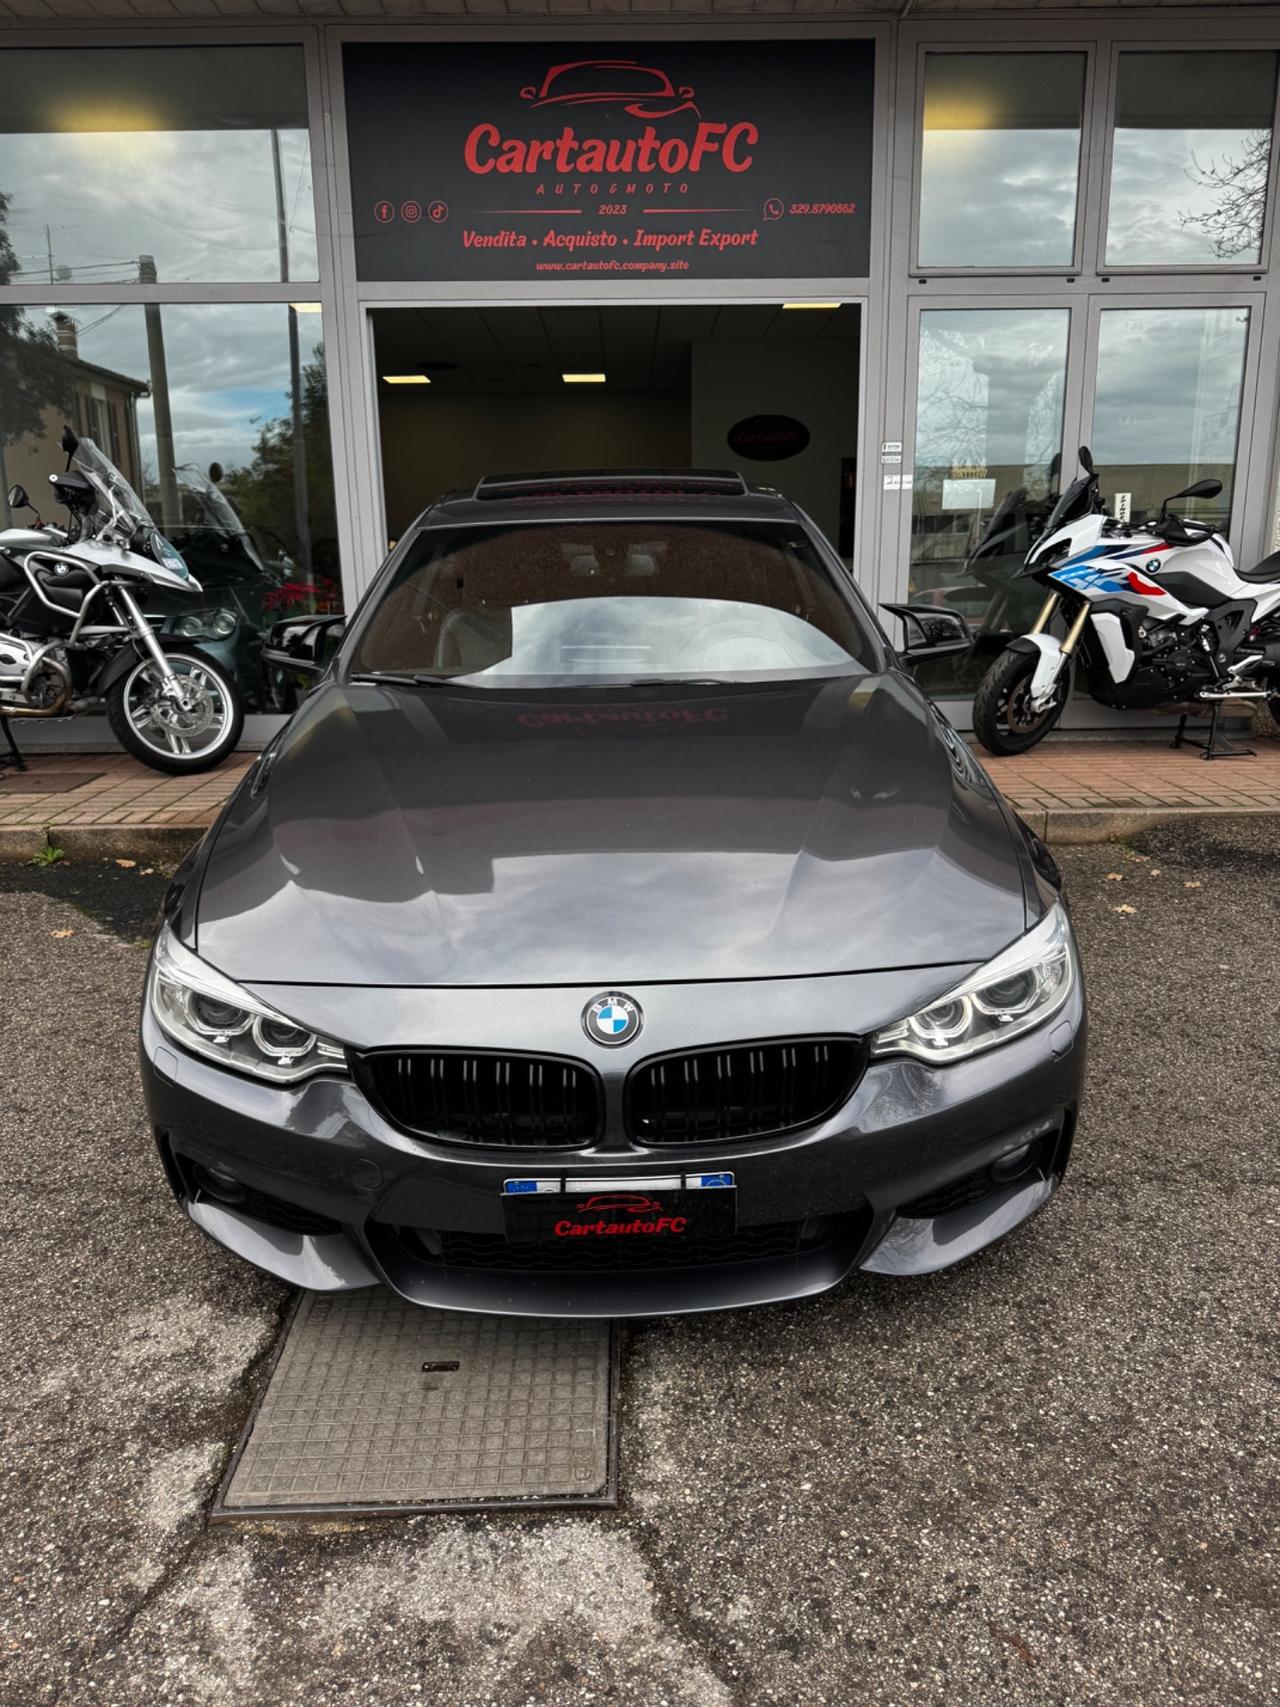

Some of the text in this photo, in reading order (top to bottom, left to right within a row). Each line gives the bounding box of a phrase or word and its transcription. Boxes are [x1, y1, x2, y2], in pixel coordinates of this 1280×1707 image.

[463, 121, 759, 175] CartautoFC
[598, 203, 628, 215] 2023
[462, 228, 759, 252] Vendita Acquisto Import Export
[535, 260, 690, 273] www.cartautofc.company.site
[591, 997, 637, 1013] BMW
[554, 1216, 688, 1236] CartautoFC
